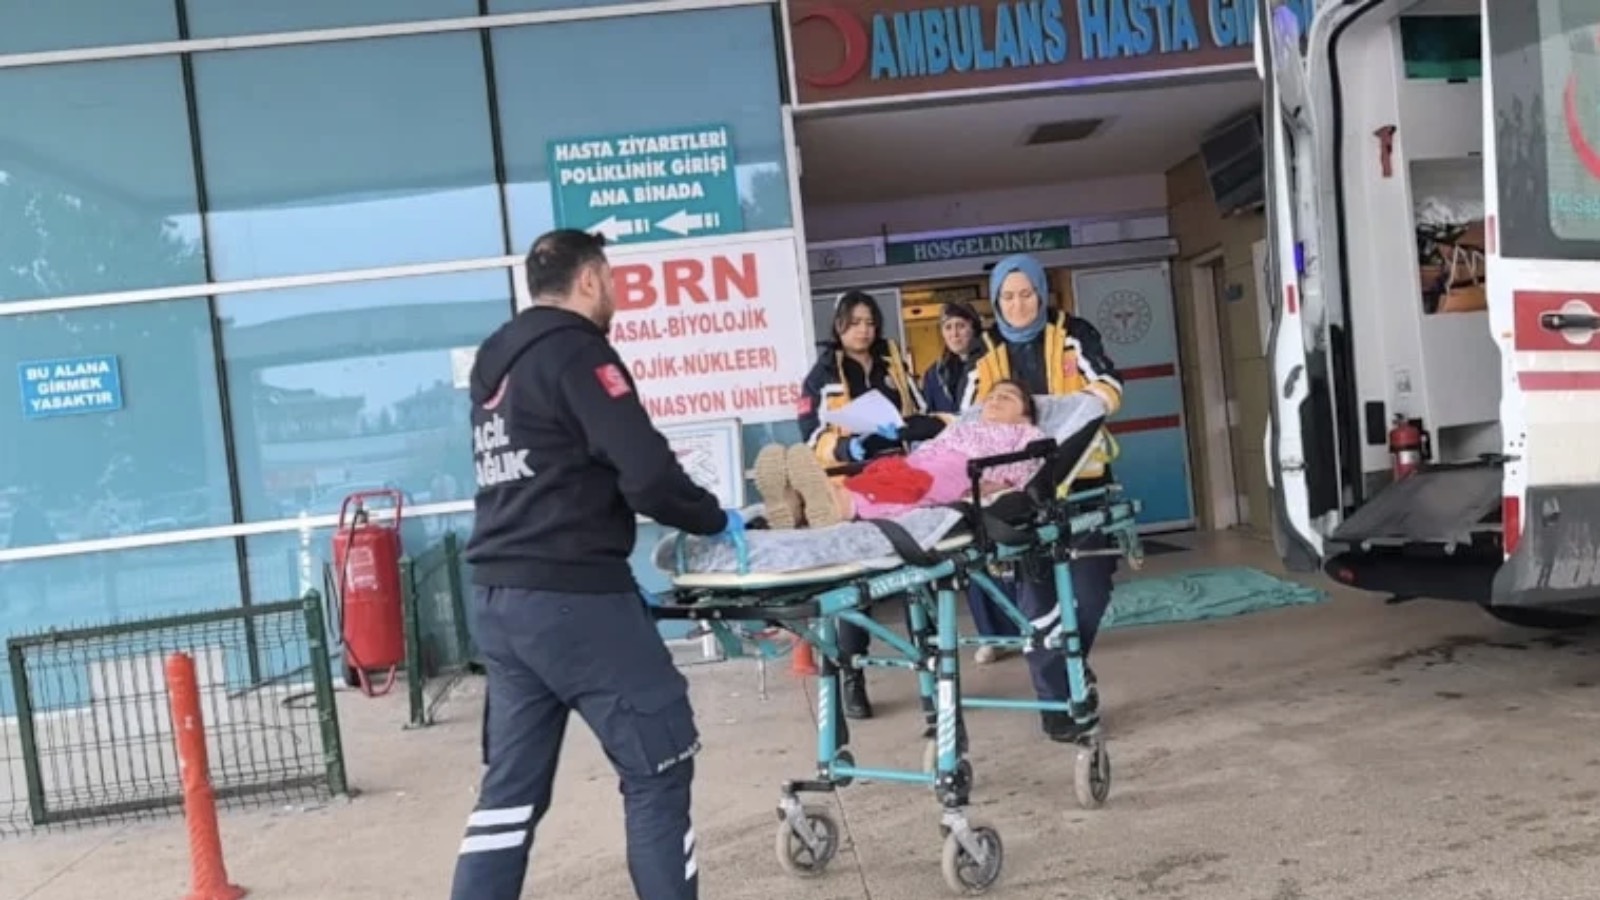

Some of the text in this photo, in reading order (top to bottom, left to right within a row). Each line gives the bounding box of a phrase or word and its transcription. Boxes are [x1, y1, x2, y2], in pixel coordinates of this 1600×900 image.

[870, 0, 1068, 80] AMBULANS
[1078, 0, 1200, 61] HASTA
[555, 126, 727, 161] HASTA ZİYARETLERİ
[560, 151, 727, 186] POLİKLİNİK GİRİŞİ
[589, 182, 704, 207] ANA BİNADA
[609, 253, 759, 311] BRN
[613, 305, 768, 343] ASAL-BİYOLOJİK
[27, 361, 110, 380] BU ALANA
[632, 345, 778, 381] OJİK-NÜKLEER)
[31, 391, 112, 411] YASAKTIR
[731, 381, 802, 410] ÜNİTES
